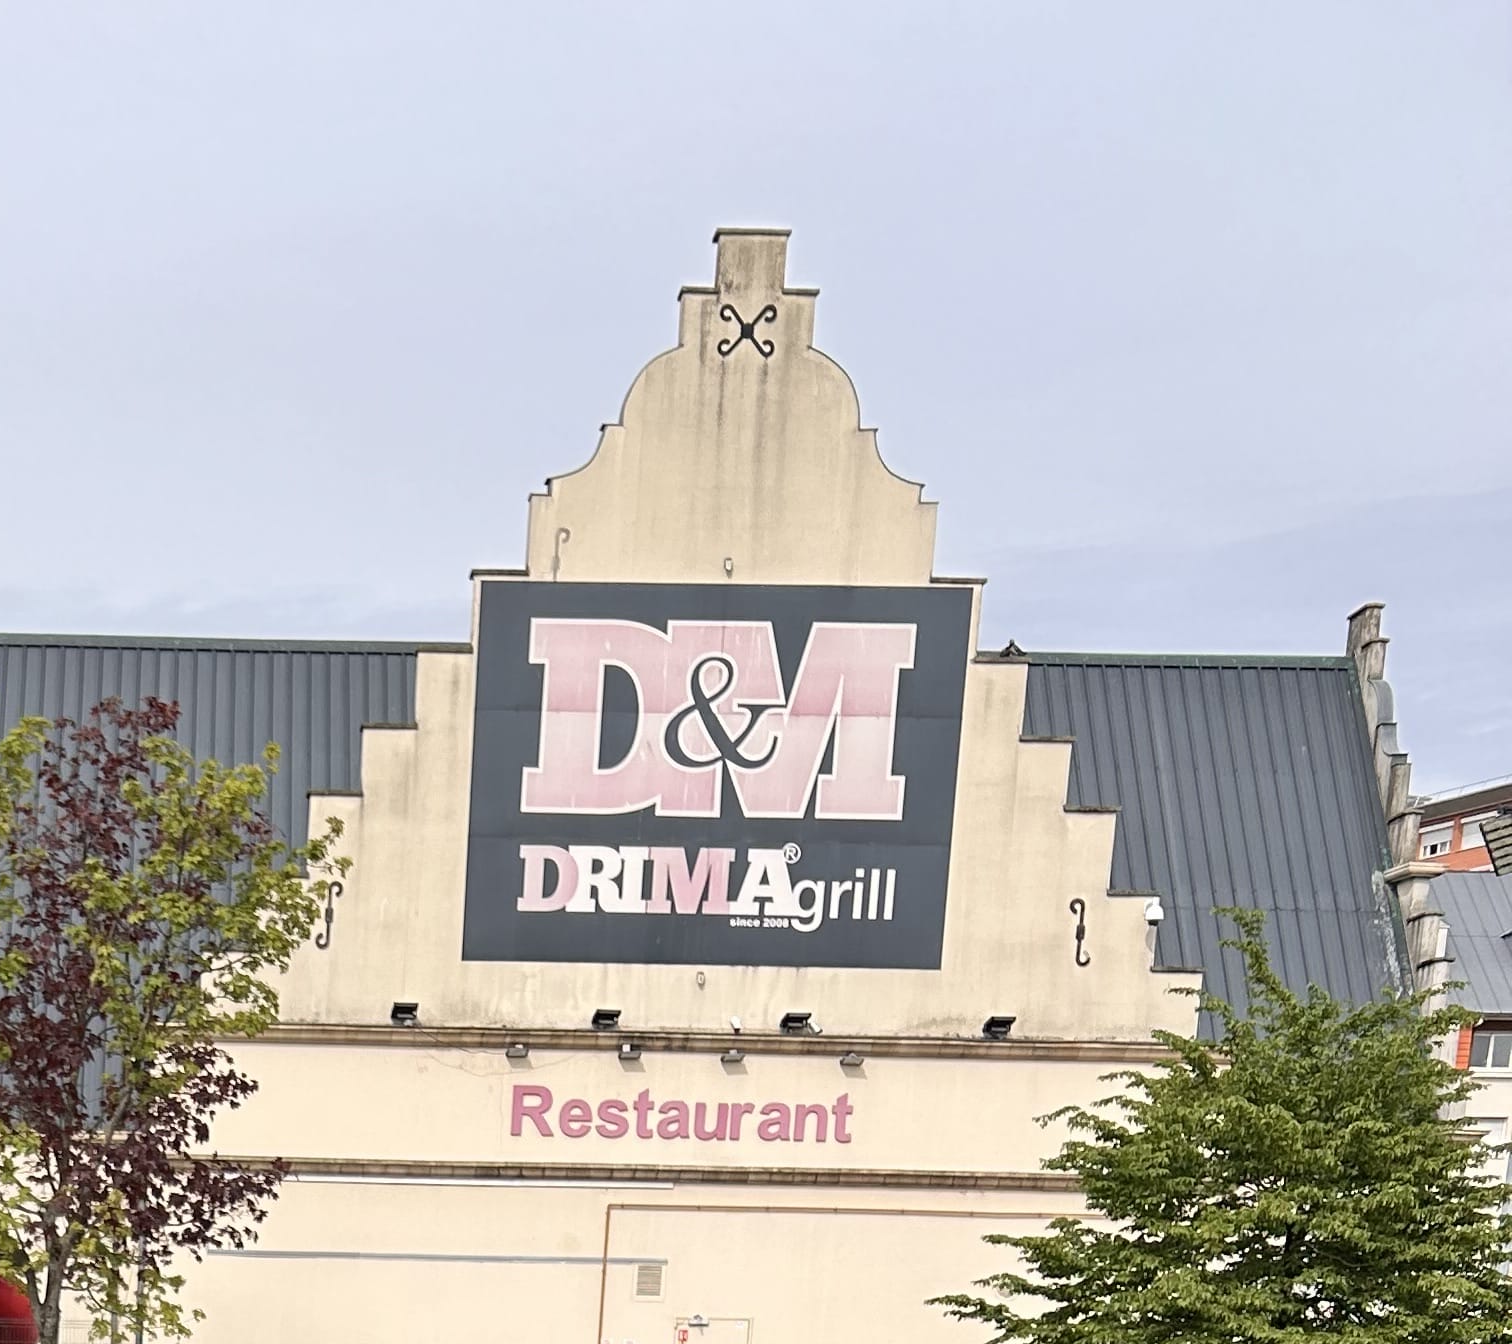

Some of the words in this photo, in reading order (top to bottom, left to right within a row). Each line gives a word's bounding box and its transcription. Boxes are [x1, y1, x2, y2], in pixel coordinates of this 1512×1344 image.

[519, 616, 918, 822] D&M
[729, 916, 761, 928] since
[510, 1084, 854, 1144] Restaurant
